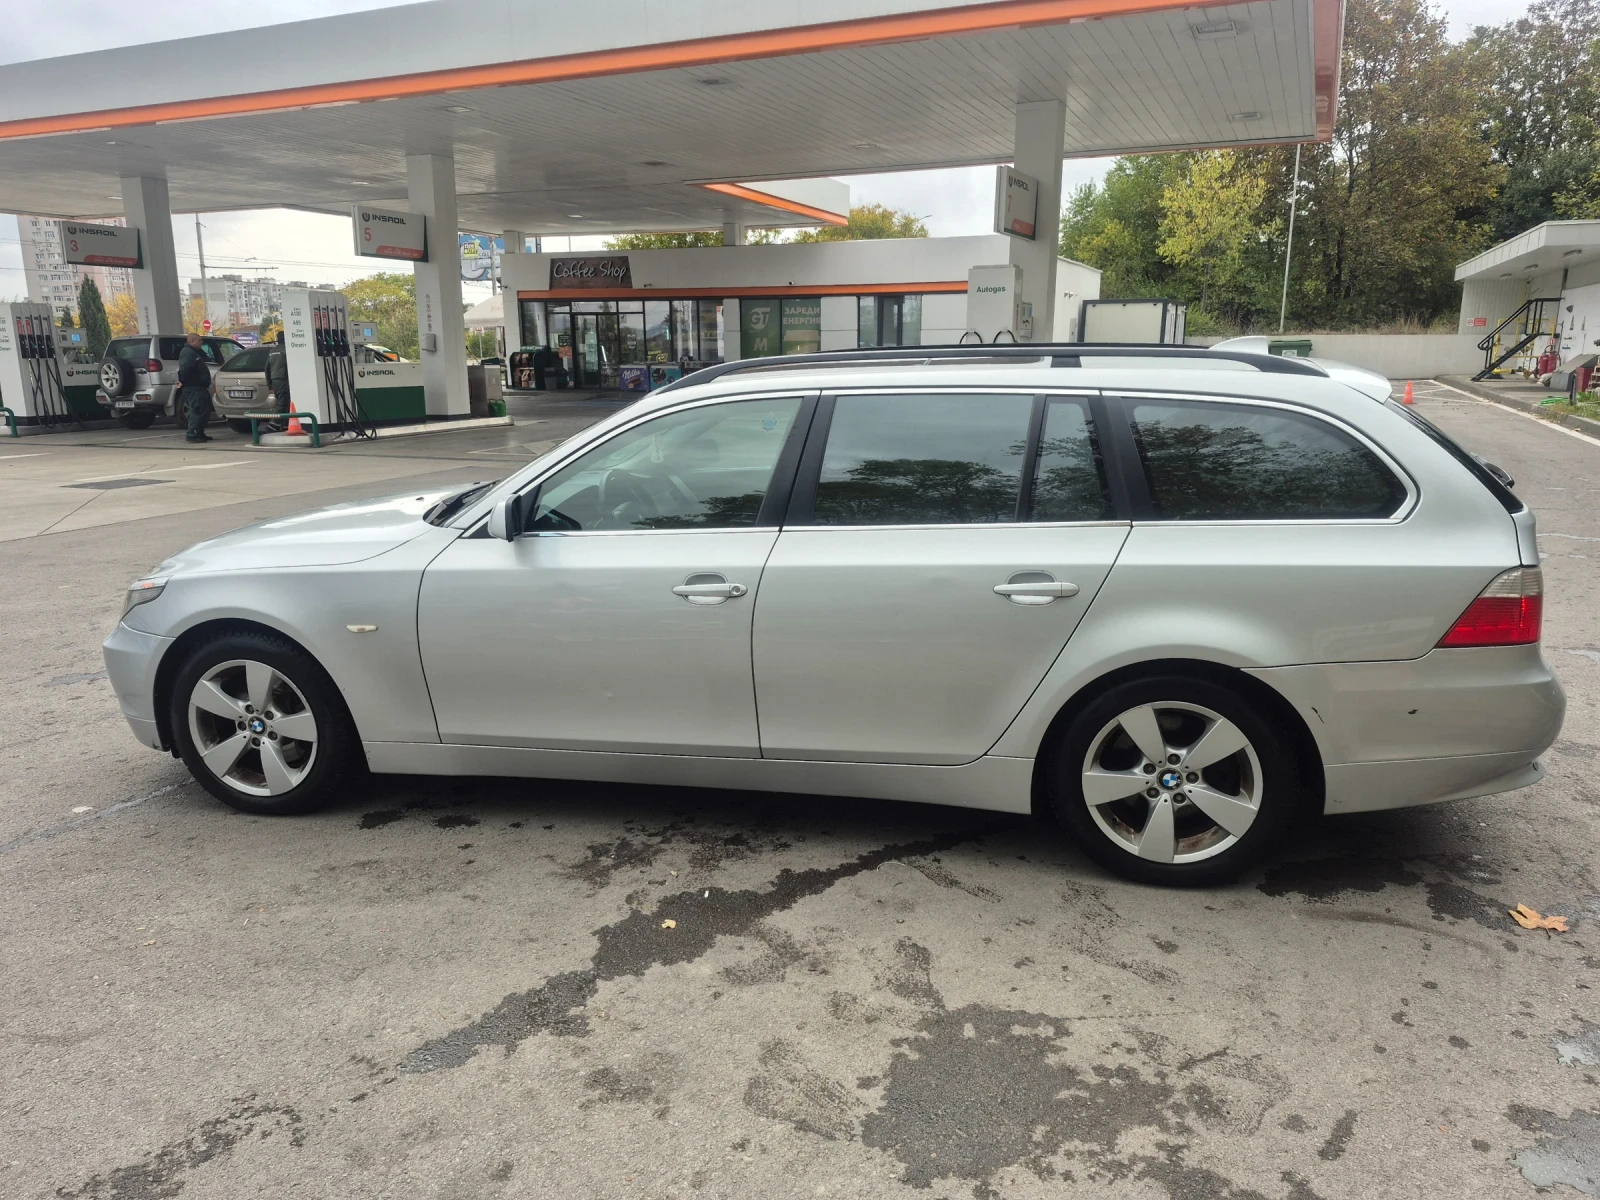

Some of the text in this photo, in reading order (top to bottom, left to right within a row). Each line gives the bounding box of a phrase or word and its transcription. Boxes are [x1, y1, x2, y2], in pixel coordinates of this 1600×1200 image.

[364, 227, 372, 242] 5
[69, 239, 79, 252] 3
[553, 260, 627, 283] Coffee Shop
[976, 286, 1006, 294] Autogas
[784, 306, 820, 315] ЗАРЕДИ
[783, 317, 821, 325] ЕНЕРГИЯ
[622, 369, 641, 380] Milka
